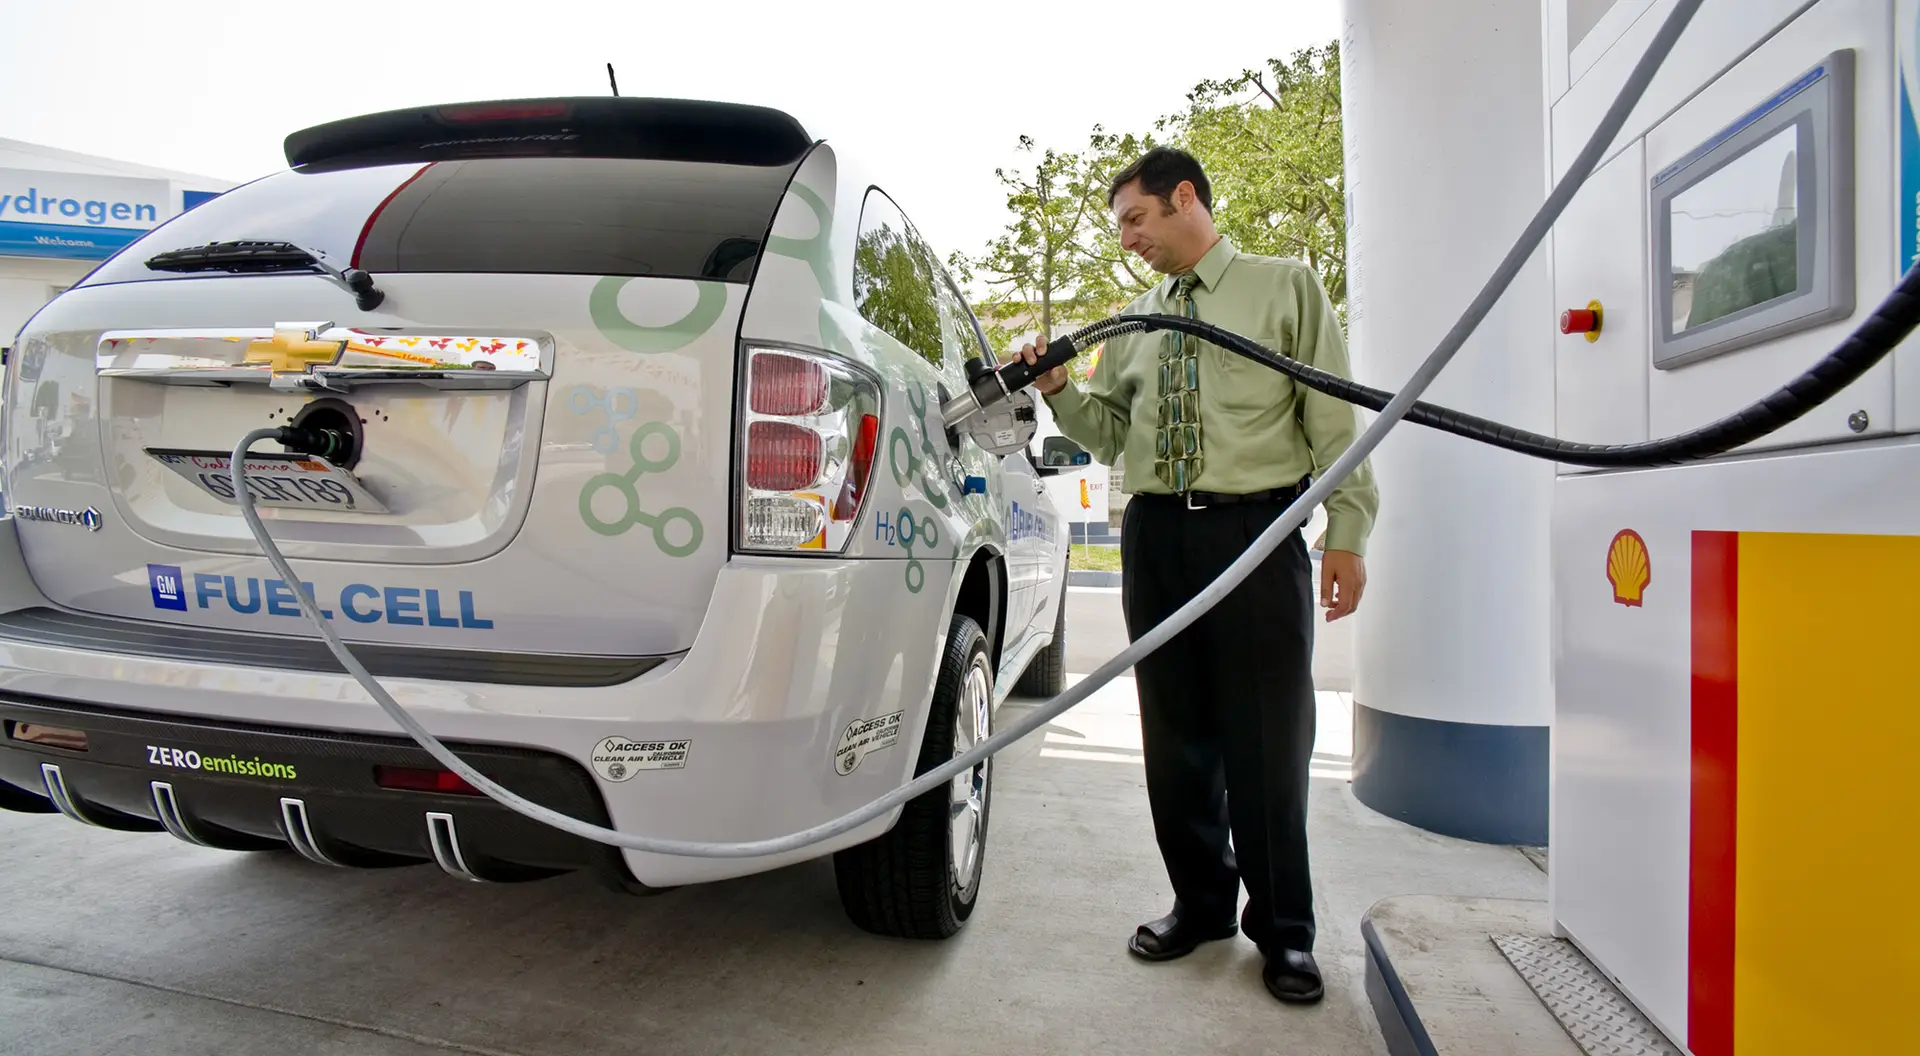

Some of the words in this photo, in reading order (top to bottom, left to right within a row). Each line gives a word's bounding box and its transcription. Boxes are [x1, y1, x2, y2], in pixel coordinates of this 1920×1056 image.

[34, 235, 95, 248] Welcome
[191, 455, 308, 473] Caliornia
[156, 575, 177, 595] GM
[340, 583, 494, 629] CELL
[852, 718, 886, 738] ACCESS
[888, 713, 902, 725] OK
[614, 742, 665, 751] ACCESS
[669, 742, 688, 750] OK
[836, 743, 857, 757] CLEAN
[858, 738, 870, 747] AIR
[872, 728, 898, 742] VEHICLE
